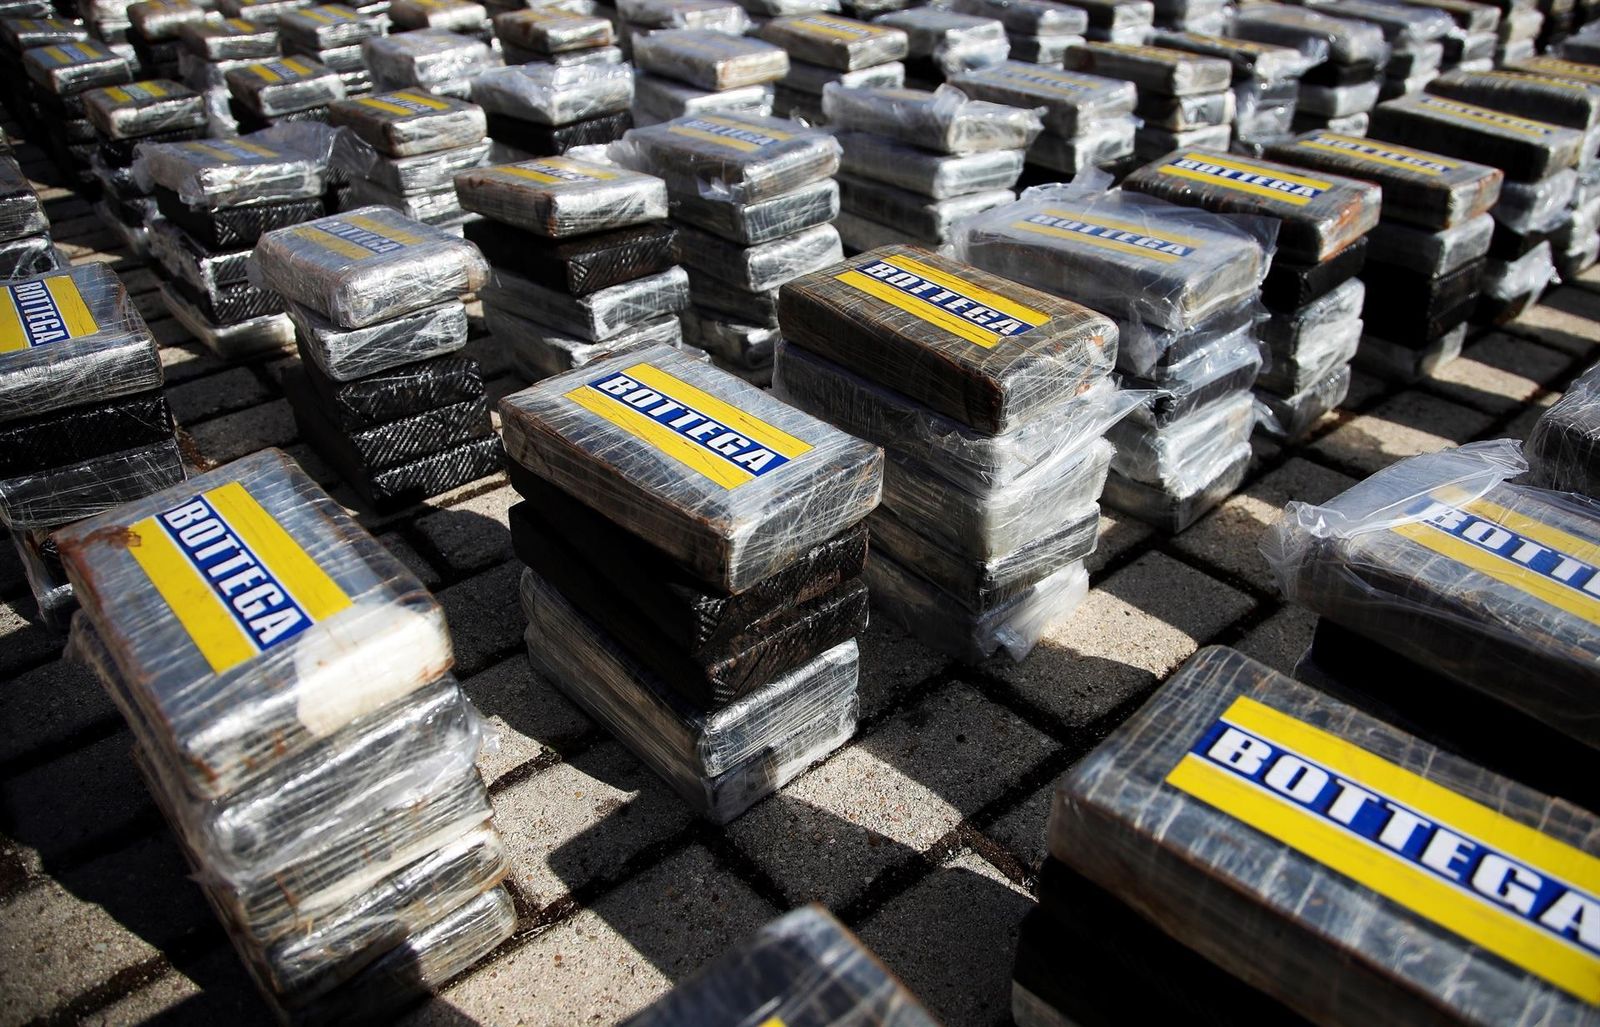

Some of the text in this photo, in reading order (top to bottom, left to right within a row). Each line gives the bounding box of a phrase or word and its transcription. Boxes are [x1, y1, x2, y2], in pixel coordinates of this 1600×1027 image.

[1174, 159, 1315, 197] BOTTEGA
[1029, 215, 1187, 254] BOTTEGA
[13, 281, 66, 345] BOTTEGA
[863, 263, 1024, 335] BOTTEGA
[597, 375, 776, 472] BOTTEGA
[163, 500, 303, 645] BOTTEGA
